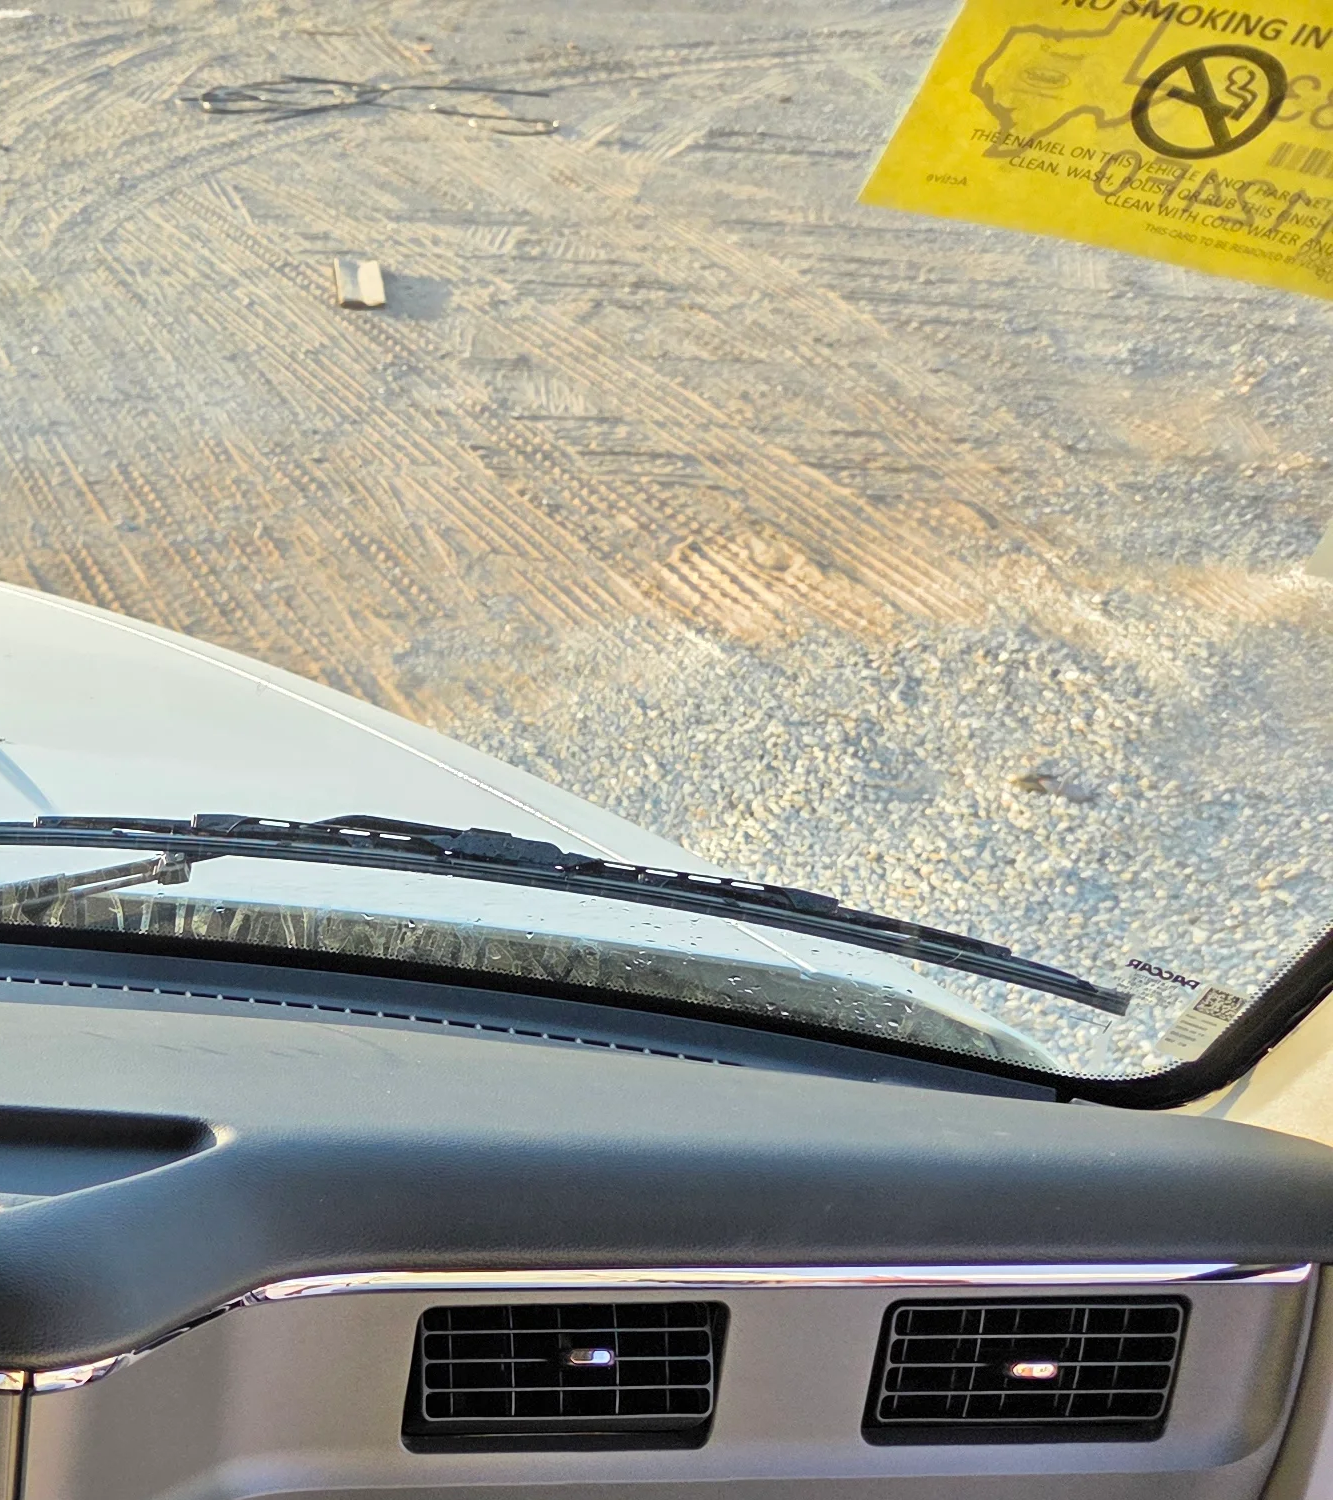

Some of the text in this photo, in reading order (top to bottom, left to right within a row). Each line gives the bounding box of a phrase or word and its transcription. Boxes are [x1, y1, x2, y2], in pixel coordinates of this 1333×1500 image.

[1121, 0, 1333, 49] SMOKING IN
[971, 129, 999, 144] THE
[1003, 134, 1067, 161] ENAMEL
[1070, 146, 1095, 161] ON
[1099, 151, 1133, 168] THIS
[1137, 159, 1200, 183] VEHICLE
[1009, 155, 1059, 177] CLEAN,
[1067, 166, 1114, 187] WASH,
[1120, 176, 1174, 200] POLISH
[1178, 188, 1200, 202] OR
[1104, 192, 1301, 246] CLEAN WITH COLD WATER
